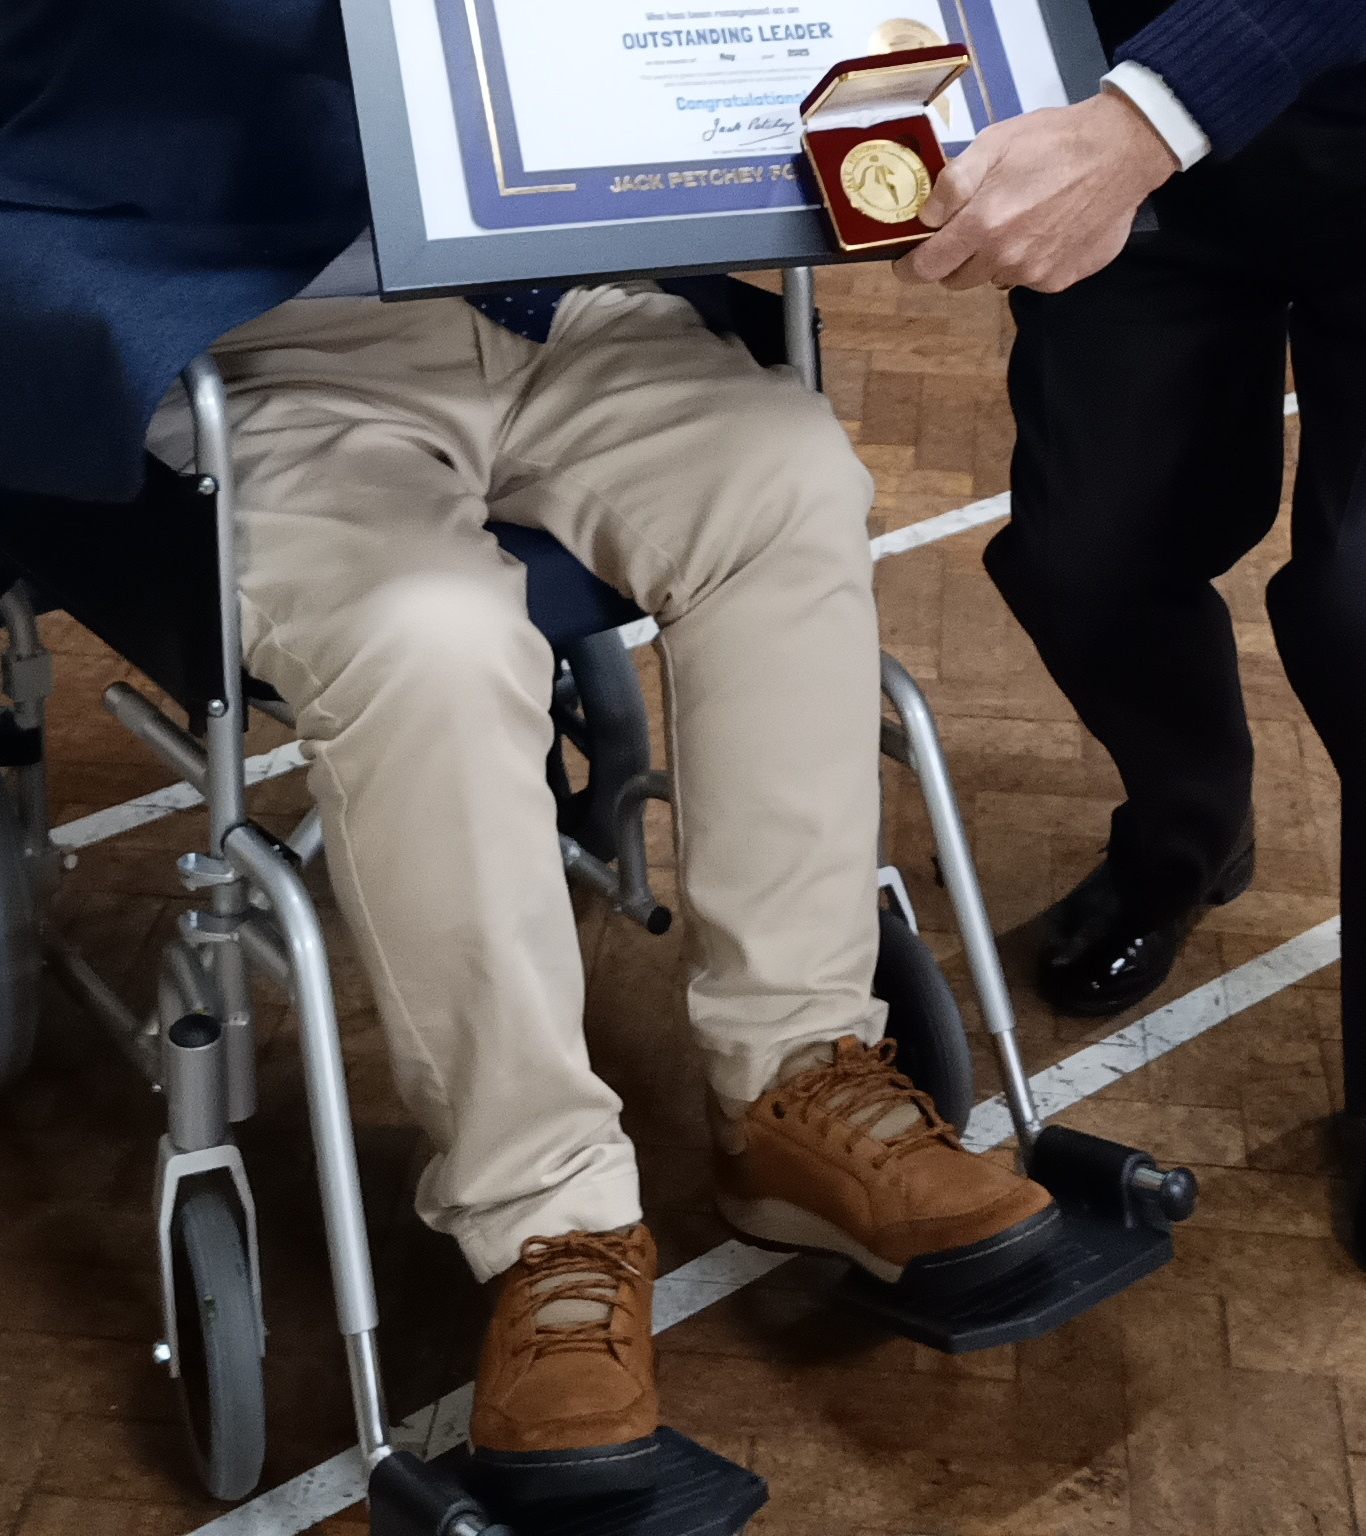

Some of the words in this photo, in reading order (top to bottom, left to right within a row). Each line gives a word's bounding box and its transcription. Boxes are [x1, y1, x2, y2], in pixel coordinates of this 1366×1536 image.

[622, 26, 753, 49] OUTSTANDING
[758, 22, 833, 41] LEADER
[610, 173, 665, 193] JACK
[668, 166, 763, 188] PETCHEY
